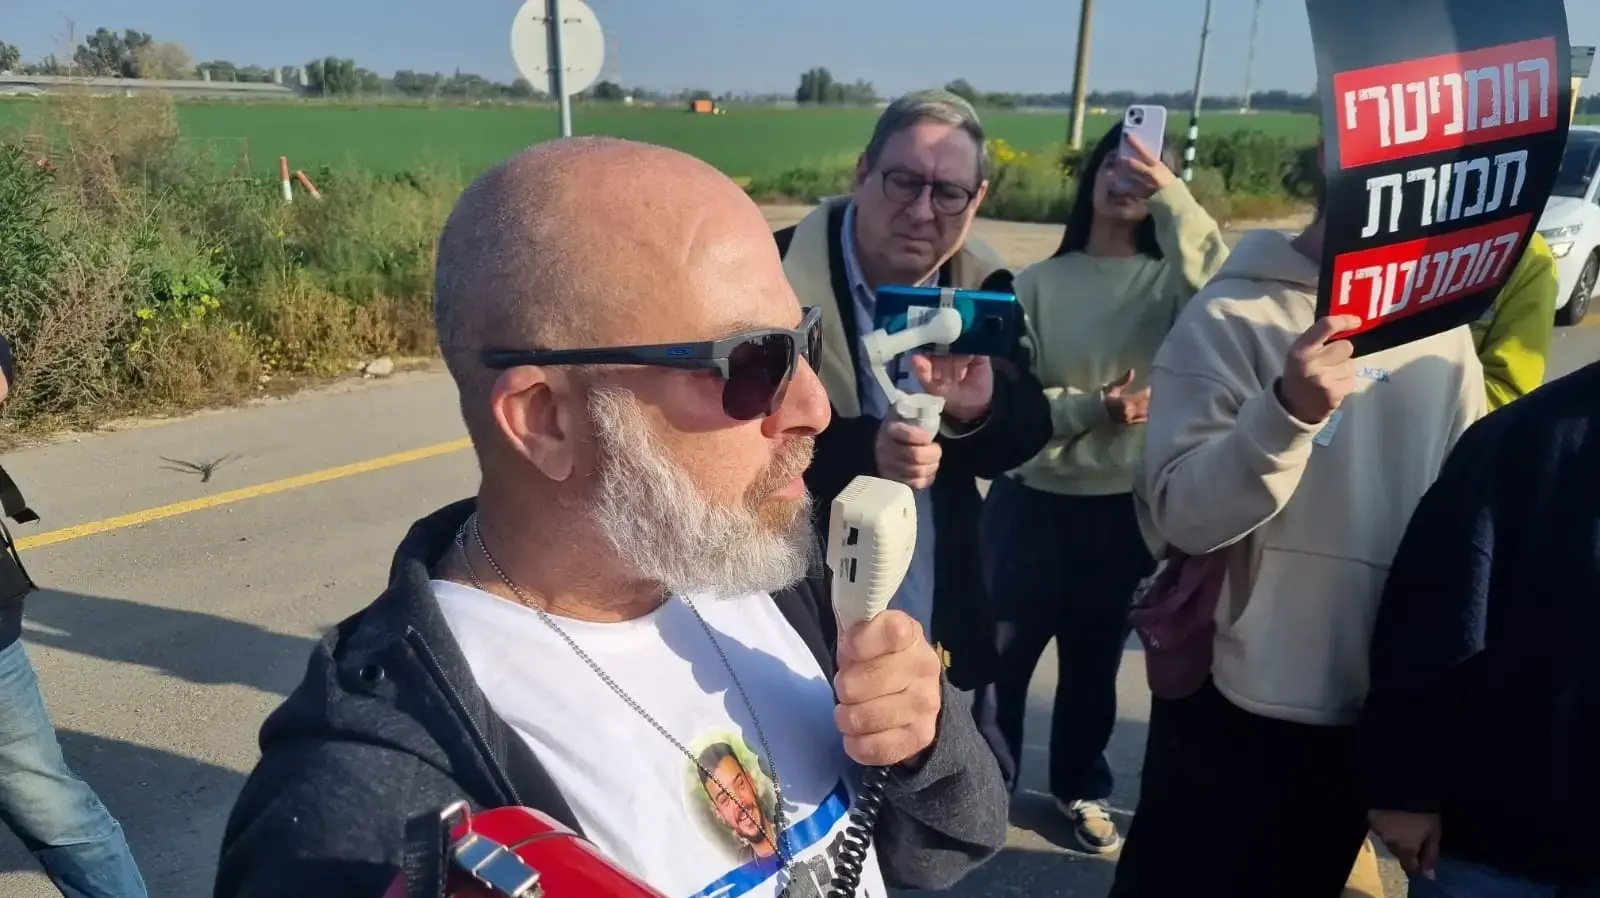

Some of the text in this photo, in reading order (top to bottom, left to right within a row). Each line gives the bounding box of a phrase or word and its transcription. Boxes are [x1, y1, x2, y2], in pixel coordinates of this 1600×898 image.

[1344, 57, 1550, 148] הומניטרי
[1360, 149, 1528, 239] תמורת
[1338, 231, 1520, 321] הומניטרי
